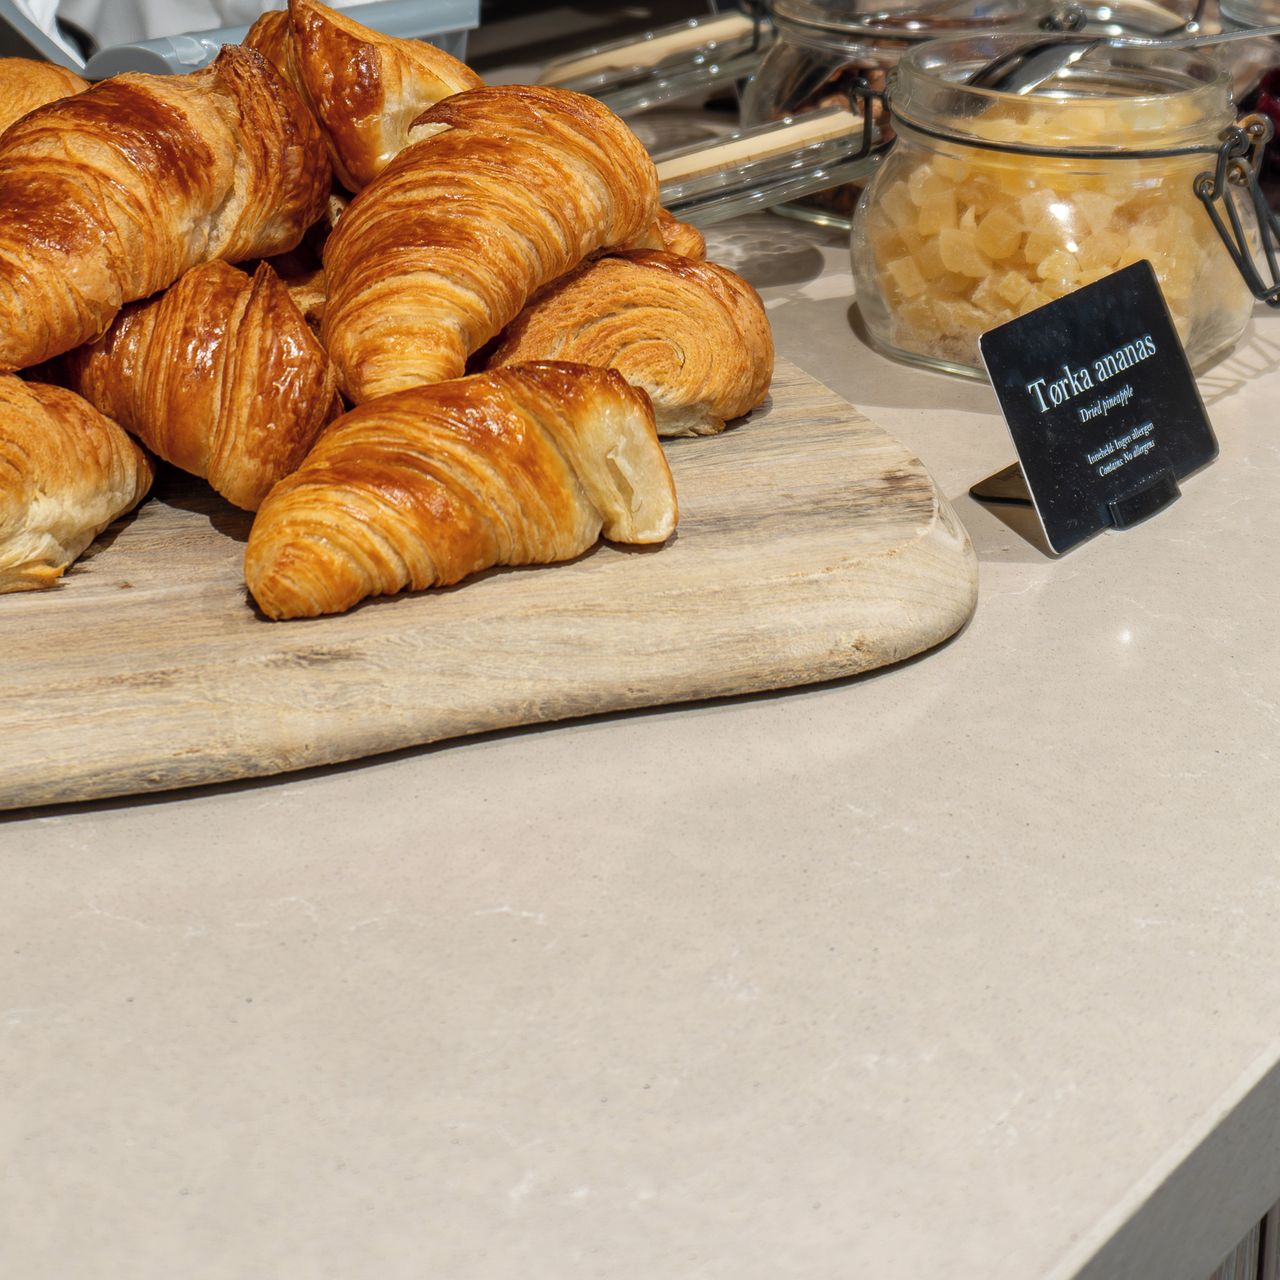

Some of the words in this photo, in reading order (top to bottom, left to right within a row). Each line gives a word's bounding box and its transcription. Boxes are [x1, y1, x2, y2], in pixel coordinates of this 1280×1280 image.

[1028, 365, 1094, 413] Tørka
[1095, 334, 1157, 381] ananas
[1079, 402, 1102, 423] Dried
[1102, 386, 1134, 416] pineapple
[1115, 433, 1131, 451] Ingen
[1131, 422, 1155, 442] allergen
[1124, 452, 1133, 465] No
